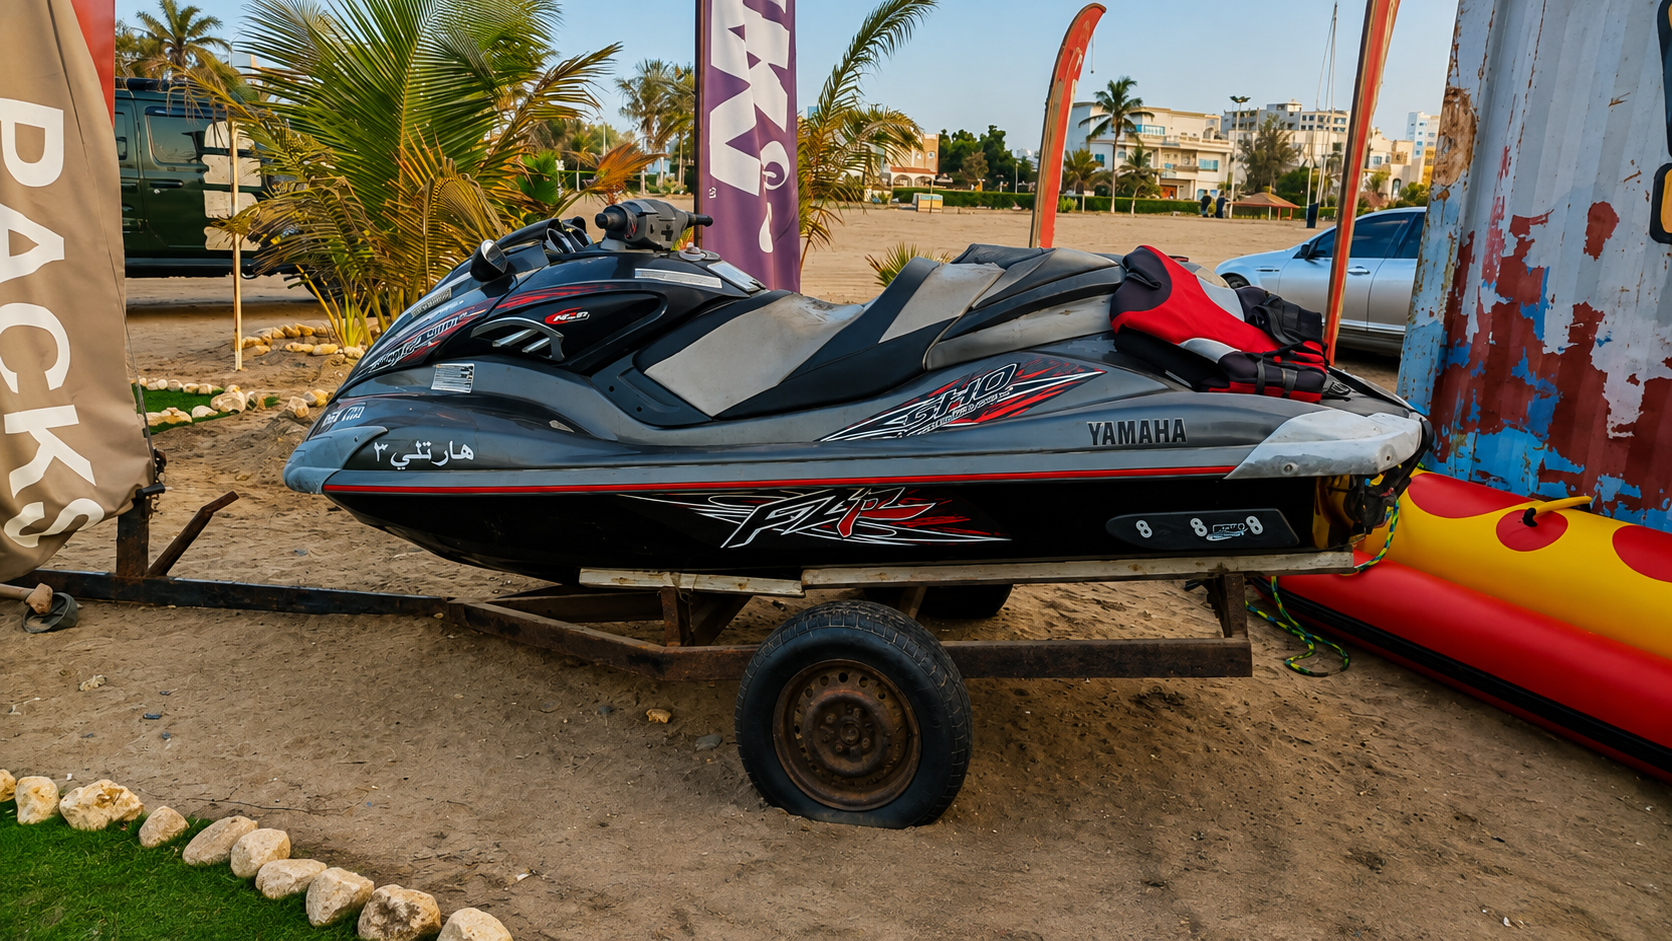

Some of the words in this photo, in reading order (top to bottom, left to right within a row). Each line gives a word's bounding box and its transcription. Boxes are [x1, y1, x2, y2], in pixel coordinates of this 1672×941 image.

[0, 97, 105, 548] PACKS
[1086, 418, 1187, 446] YAMAHA
[1136, 519, 1153, 539] 8
[1190, 517, 1208, 537] 8
[1246, 515, 1263, 535] 8
